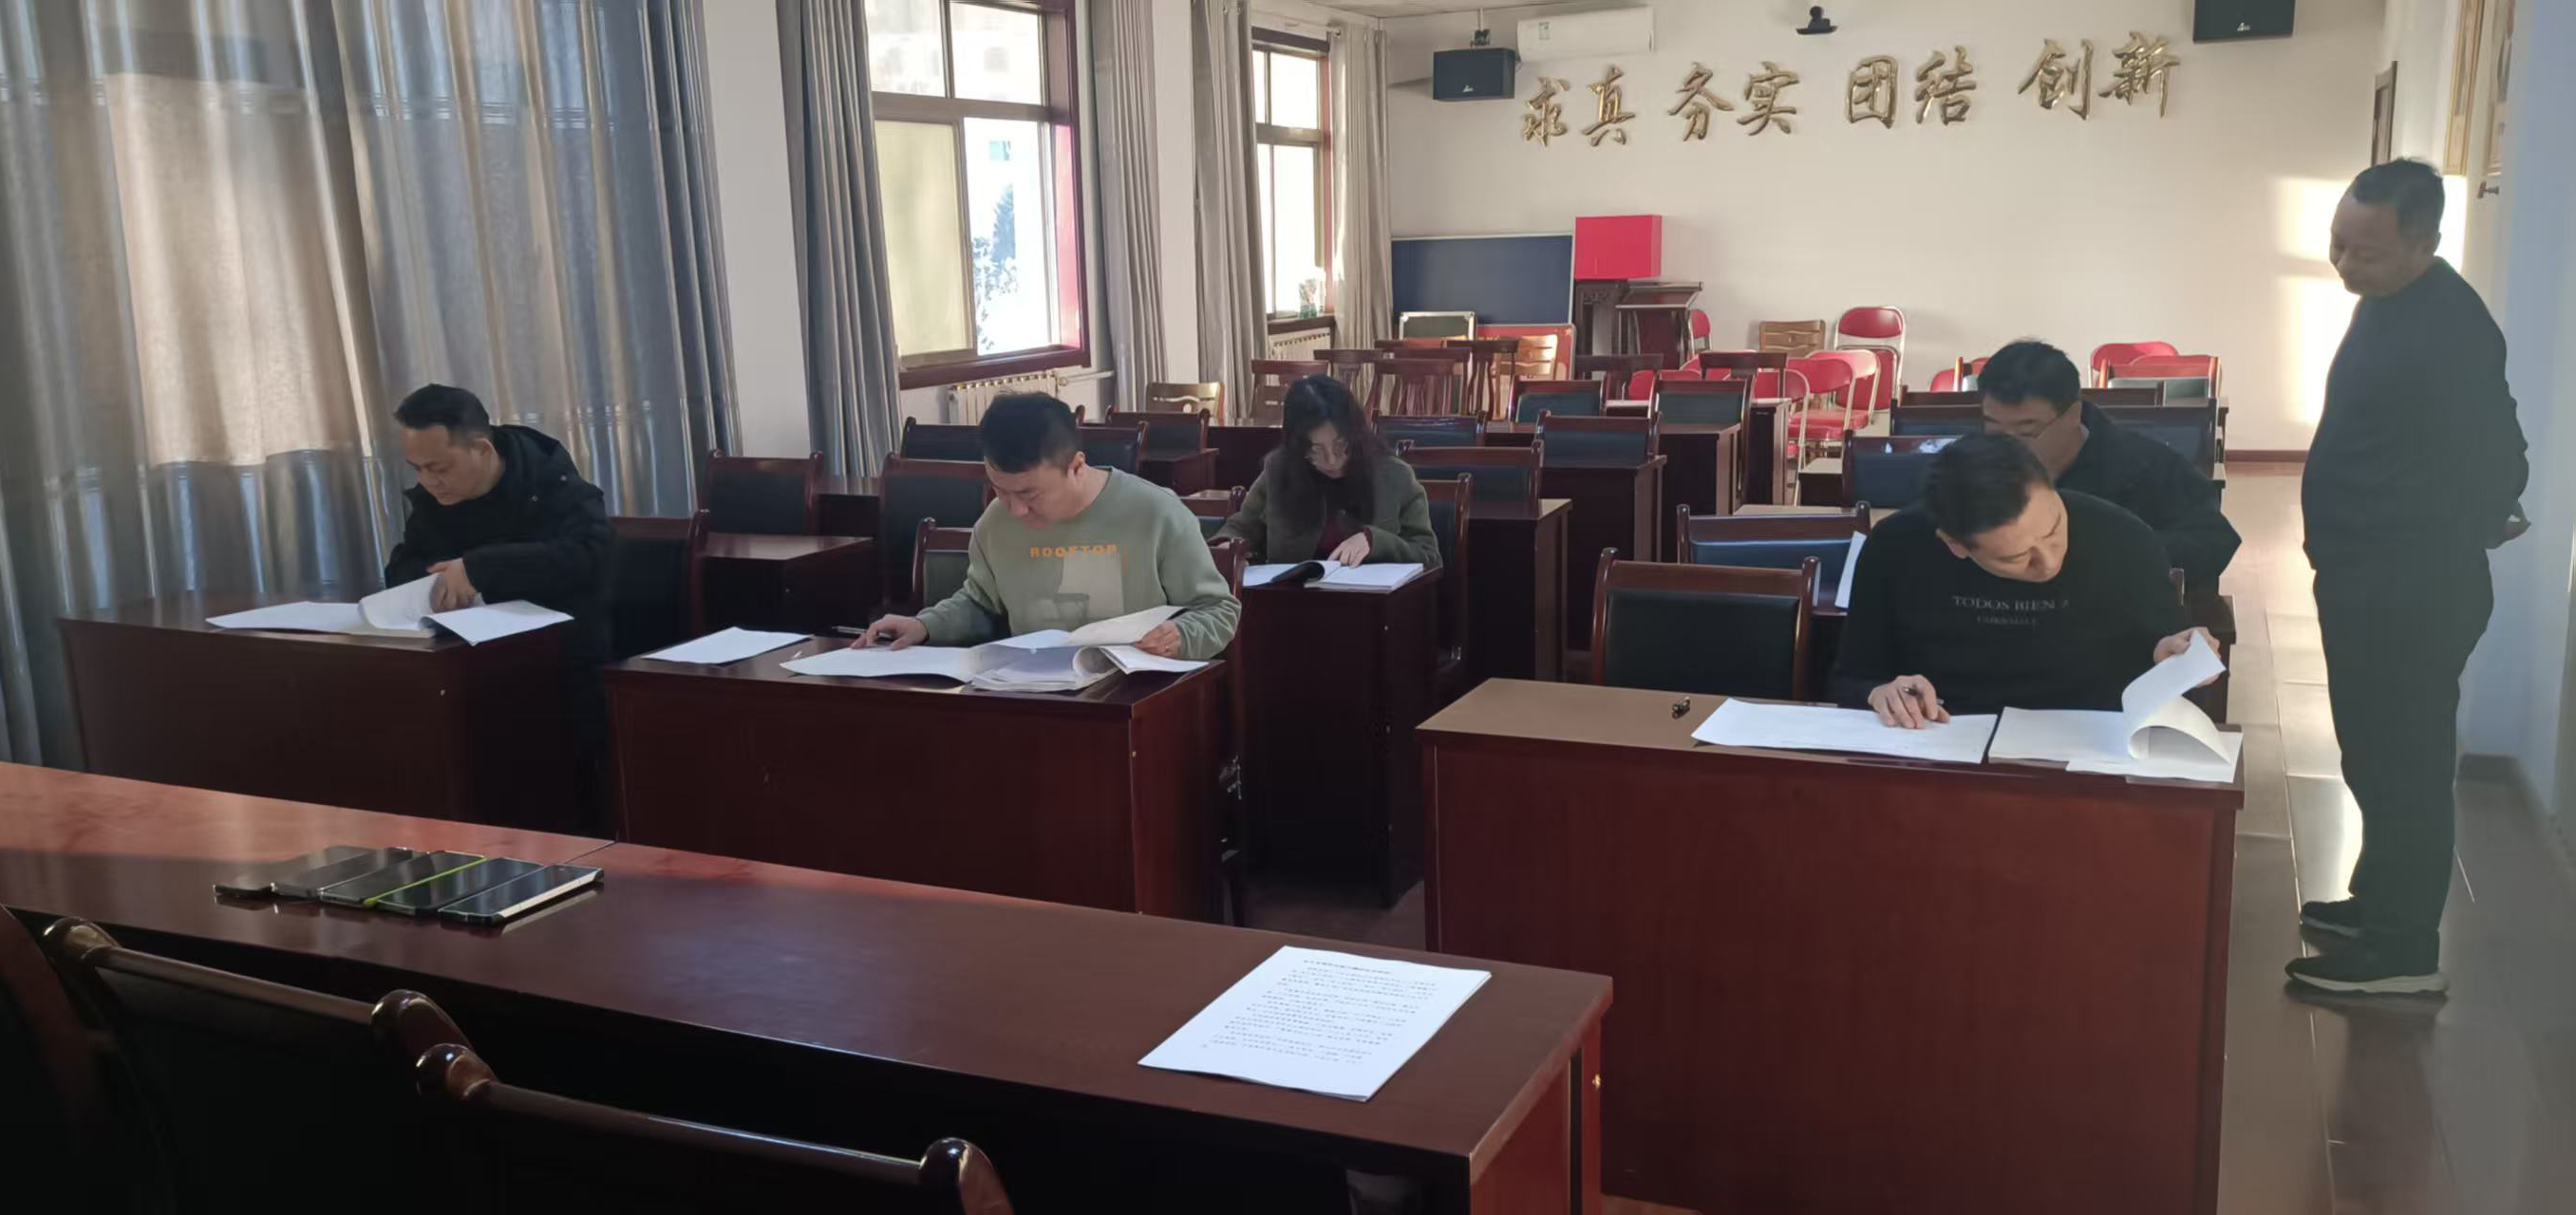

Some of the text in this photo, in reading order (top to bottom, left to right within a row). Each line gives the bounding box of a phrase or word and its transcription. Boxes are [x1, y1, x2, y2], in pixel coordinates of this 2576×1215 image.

[1521, 32, 2180, 147] 求真 务实 团结 创新
[1952, 595, 2009, 610] TODOS
